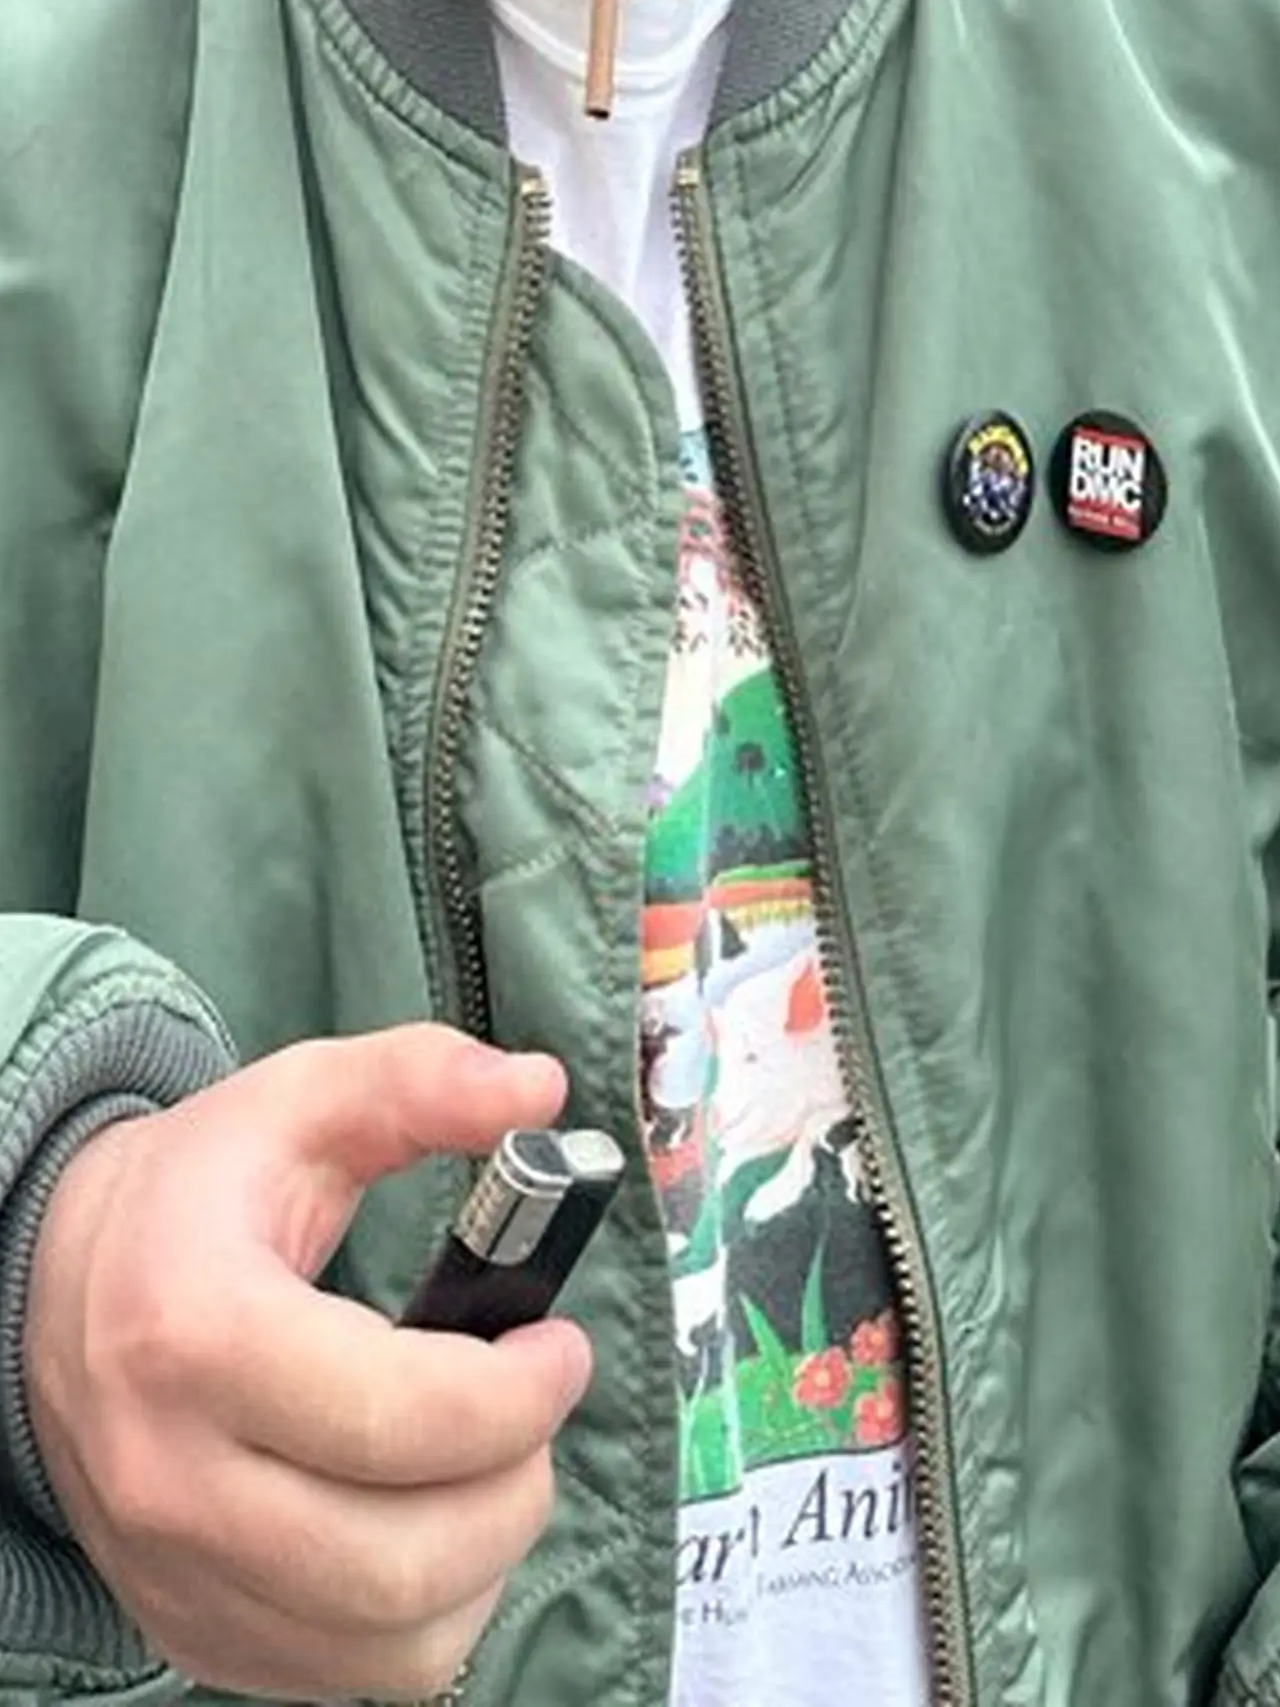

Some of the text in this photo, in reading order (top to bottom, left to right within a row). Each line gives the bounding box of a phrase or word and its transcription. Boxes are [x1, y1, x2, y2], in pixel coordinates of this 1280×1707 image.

[1072, 435, 1143, 484] RUN
[1071, 471, 1142, 512] DMC
[781, 1462, 910, 1549] Ani
